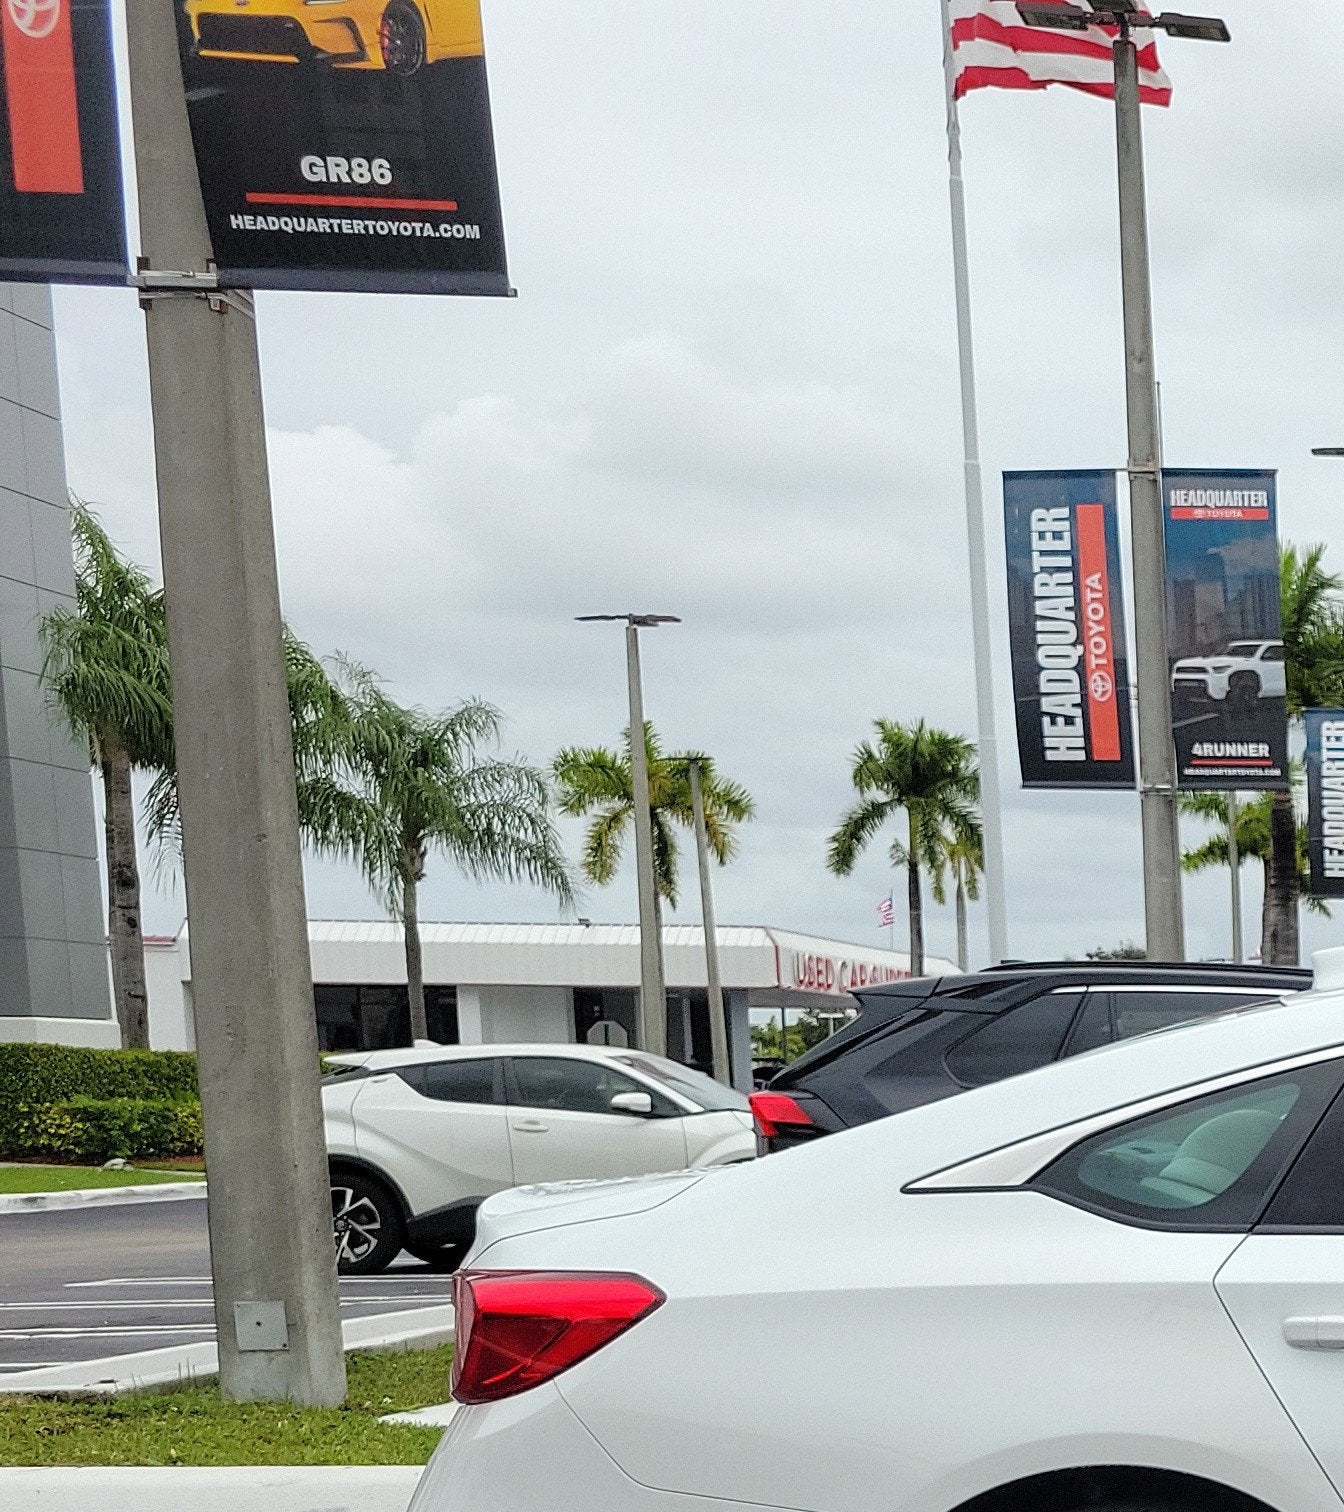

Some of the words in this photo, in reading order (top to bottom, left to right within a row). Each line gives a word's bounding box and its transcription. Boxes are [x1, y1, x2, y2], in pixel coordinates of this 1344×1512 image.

[301, 155, 393, 185] GR86
[230, 214, 481, 239] HEADQUARTERTOYOTA.COM
[1170, 488, 1268, 508] HEADQUARTER
[1030, 506, 1087, 761] HEADQUARTER
[1085, 572, 1107, 669] TOYOTA
[1191, 742, 1271, 757] 4RUNNER
[794, 952, 834, 989] USED
